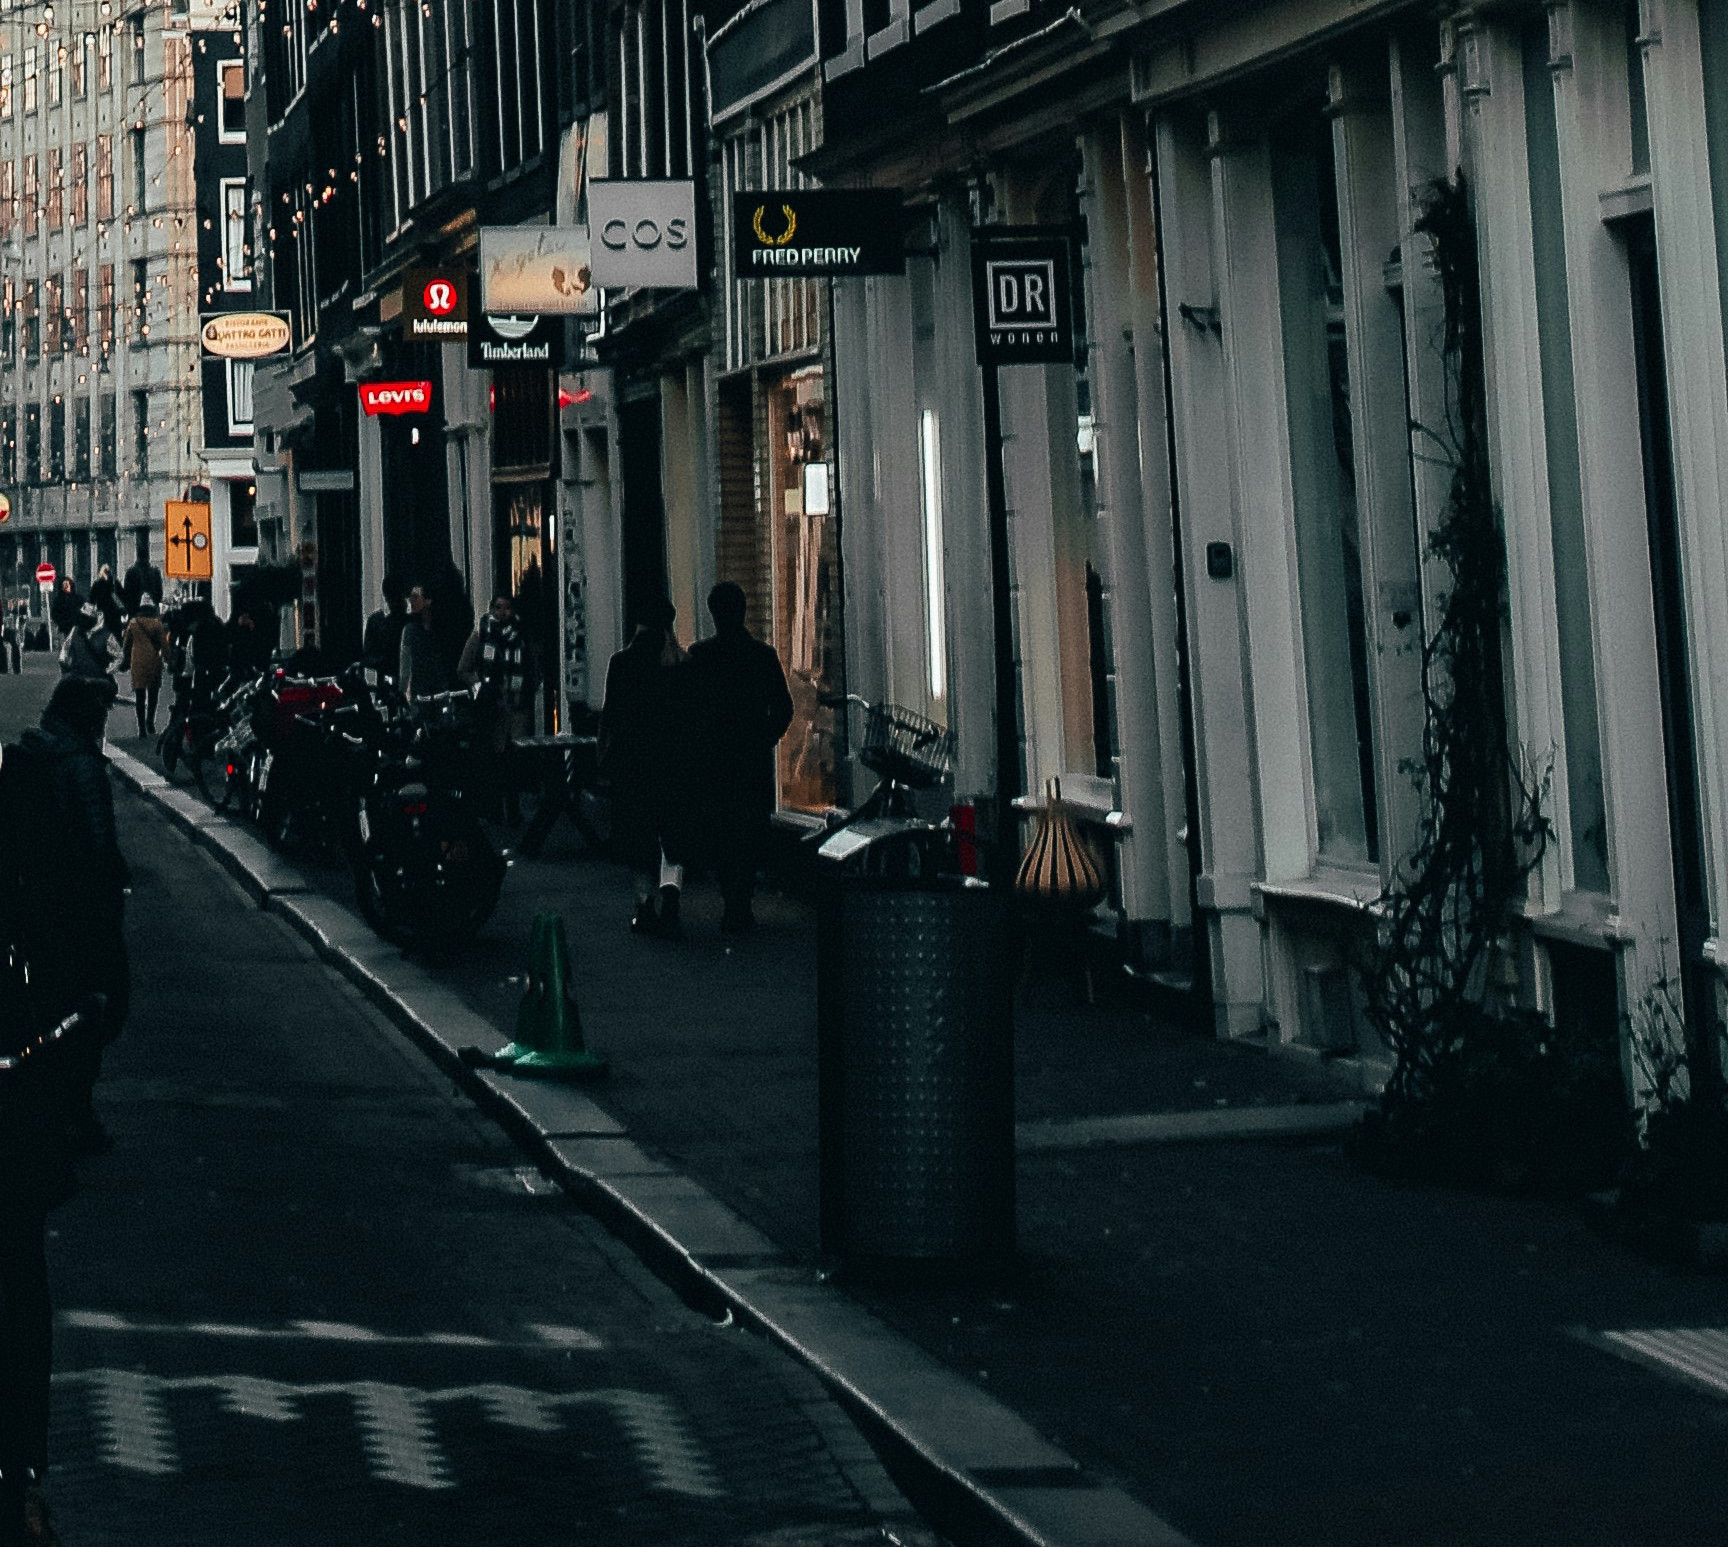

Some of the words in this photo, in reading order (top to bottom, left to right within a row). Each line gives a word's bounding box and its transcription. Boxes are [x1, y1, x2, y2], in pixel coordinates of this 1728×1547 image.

[600, 217, 688, 251] COS
[752, 248, 799, 266] FRED
[801, 247, 861, 265] PERRY
[999, 273, 1045, 313] DR
[413, 318, 468, 334] lululemon
[990, 331, 1058, 345] wonen
[480, 342, 549, 360] Timberland
